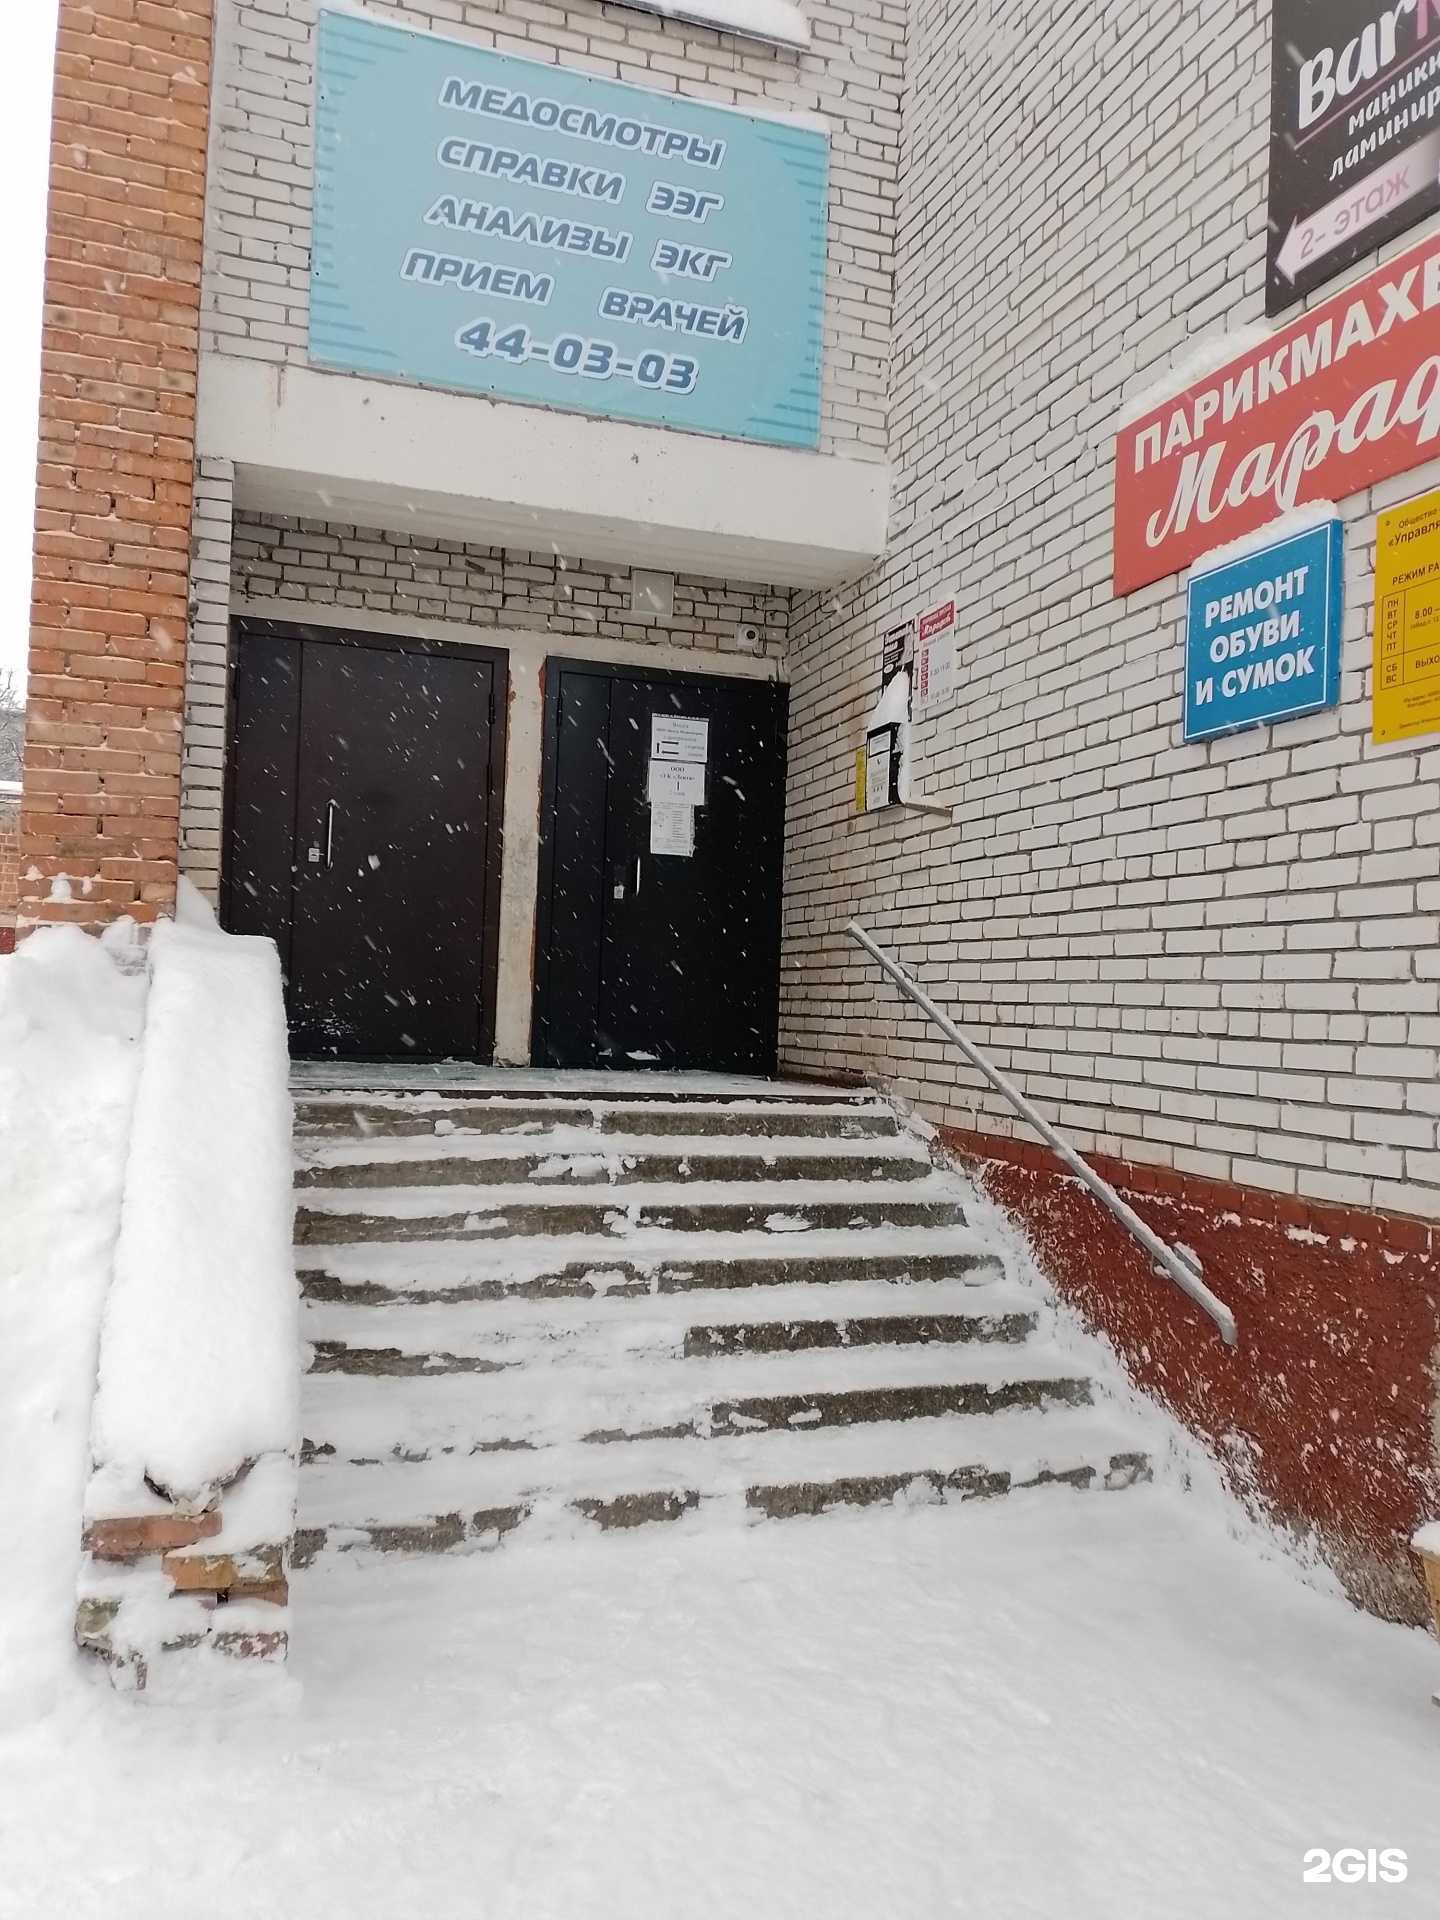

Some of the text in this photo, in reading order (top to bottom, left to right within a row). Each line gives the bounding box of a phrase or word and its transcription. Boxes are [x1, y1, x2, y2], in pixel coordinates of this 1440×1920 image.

[441, 79, 724, 167] МЕДОСМОТРЫ
[439, 140, 722, 221] СПРАВКИ ЭЭГ
[1334, 165, 1411, 237] этаж
[425, 197, 730, 280] АНАЛИЗЫ ЭКГ
[404, 251, 748, 342] ПРИЕМ ВРАЧЕЙ
[458, 321, 699, 392] 44-03-03
[1134, 252, 1440, 474] ПАРИКМАХЕ
[1205, 565, 1309, 628] РЕМОНТ
[1387, 599, 1399, 609] ПН
[1392, 566, 1426, 585] РЕЖИМ
[1209, 610, 1300, 664] ОБУВИ
[1386, 631, 1397, 640] ЧТ
[1387, 606, 1433, 620] ВТ 8.00
[1387, 620, 1398, 630] СР
[1194, 645, 1316, 706] И СУМОК
[1385, 663, 1398, 673] СБ
[1386, 642, 1397, 652] ПТ
[1385, 674, 1397, 684] ВС
